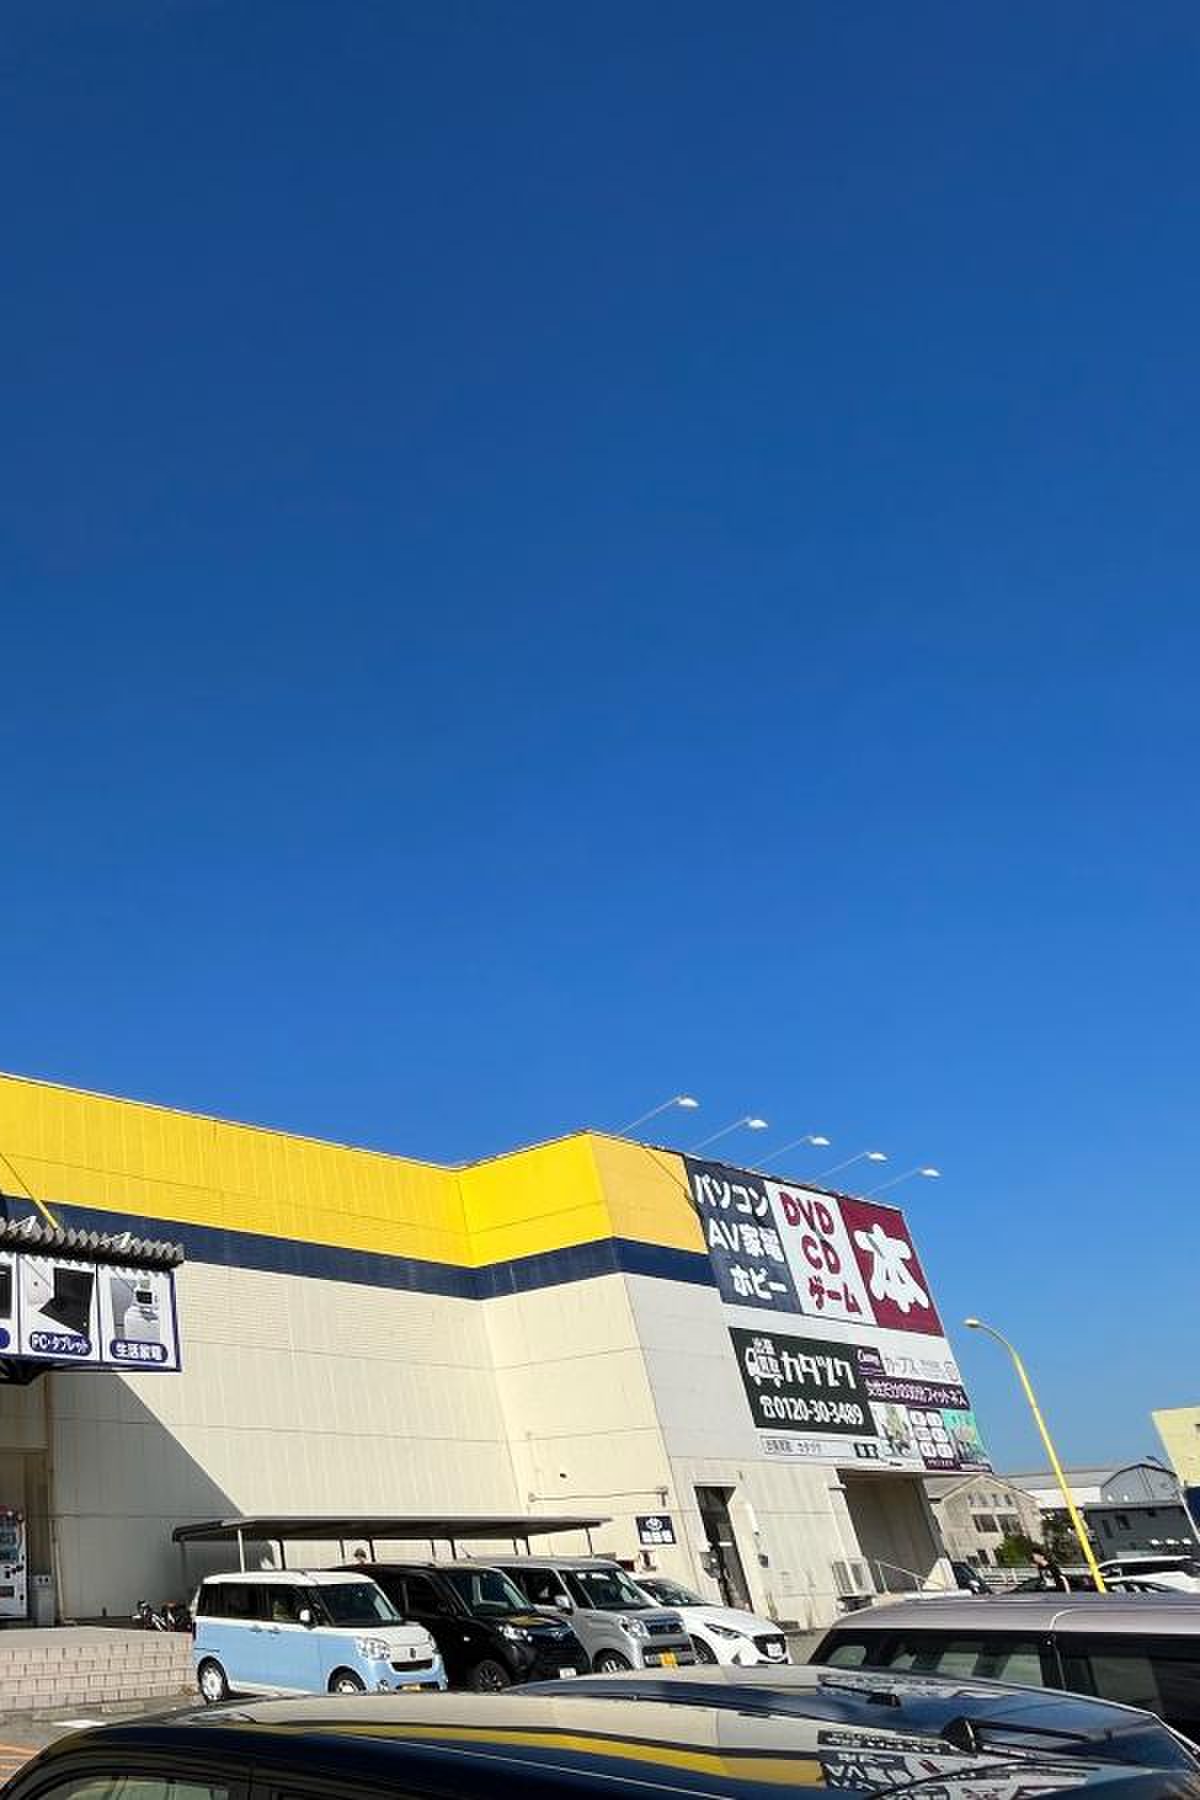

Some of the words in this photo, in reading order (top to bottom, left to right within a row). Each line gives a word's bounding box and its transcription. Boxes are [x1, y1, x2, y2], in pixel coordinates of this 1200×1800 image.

[694, 1174, 768, 1217] パソコン
[779, 1191, 834, 1235] DVD
[708, 1218, 785, 1263] AV家電
[801, 1234, 841, 1275] CD
[729, 1264, 788, 1300] ホビー
[854, 1223, 929, 1313] 本
[807, 1275, 863, 1316] ゲーム
